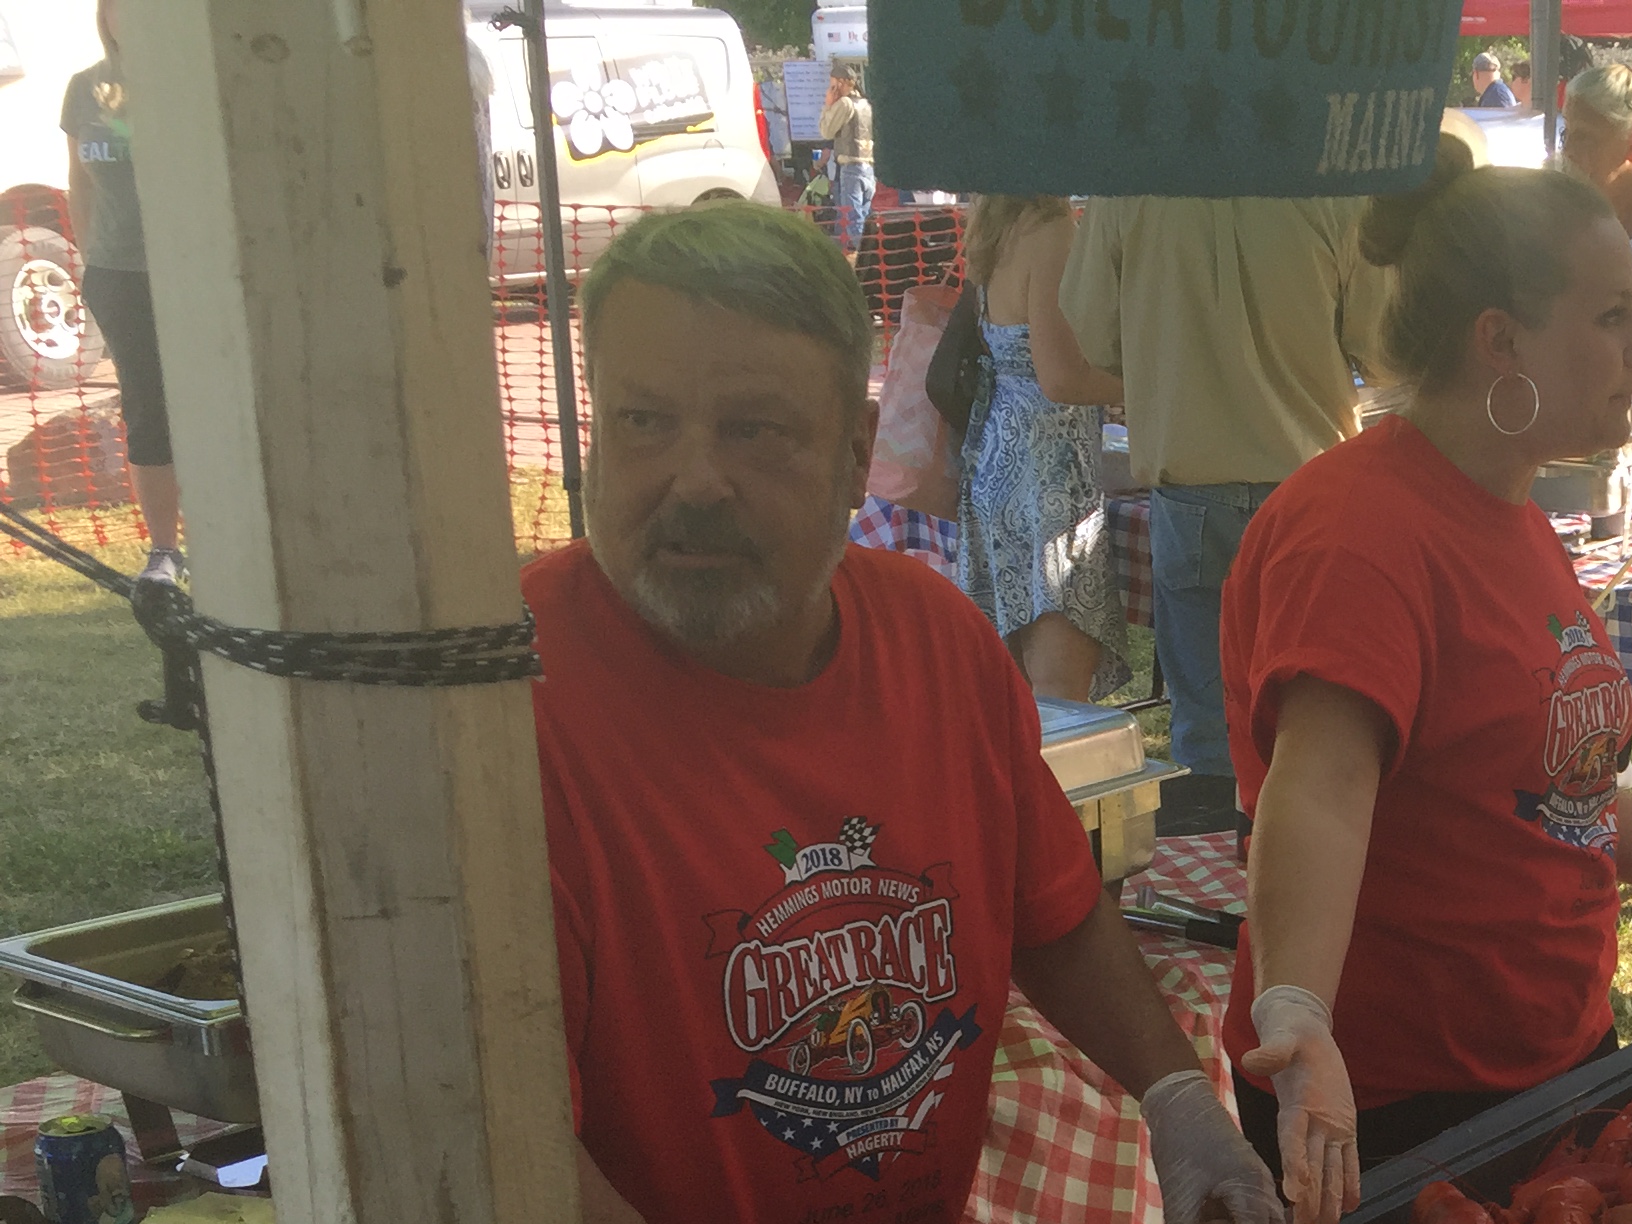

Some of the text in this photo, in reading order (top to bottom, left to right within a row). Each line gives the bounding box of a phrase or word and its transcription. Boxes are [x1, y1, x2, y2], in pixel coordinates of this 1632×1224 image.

[1317, 87, 1435, 176] MAINE
[801, 847, 843, 875] 2018
[756, 876, 921, 938] HEMMINGS MOTOR NEWS
[765, 1073, 841, 1107] BUFFALO,
[844, 1086, 864, 1105] NY
[881, 1050, 931, 1096] HALIFAX,
[925, 1031, 945, 1057] NS
[845, 1132, 905, 1160] HAGERTY
[846, 1118, 899, 1141] PRESENTED BY
